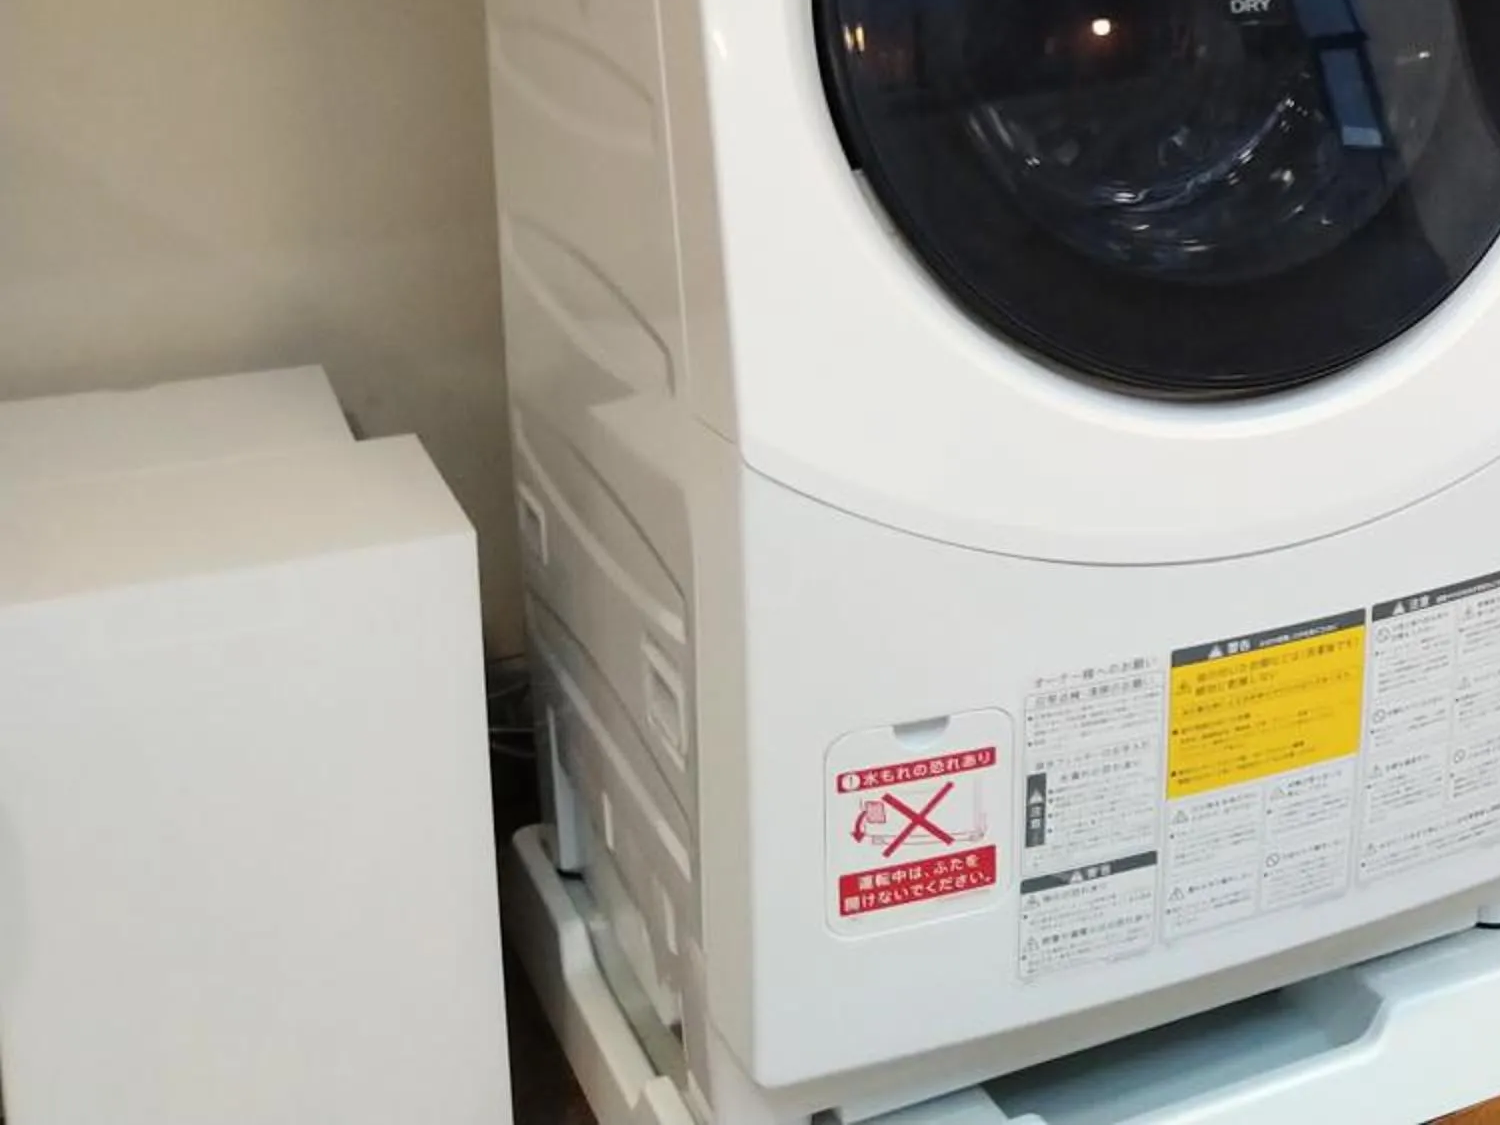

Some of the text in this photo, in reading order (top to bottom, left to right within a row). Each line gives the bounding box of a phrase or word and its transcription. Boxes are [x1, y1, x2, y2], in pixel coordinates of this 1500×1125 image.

[863, 751, 991, 786] 水もれの恐れあり
[859, 853, 980, 891] 運転中は、ふたを
[844, 872, 993, 913] 開けないでください。
